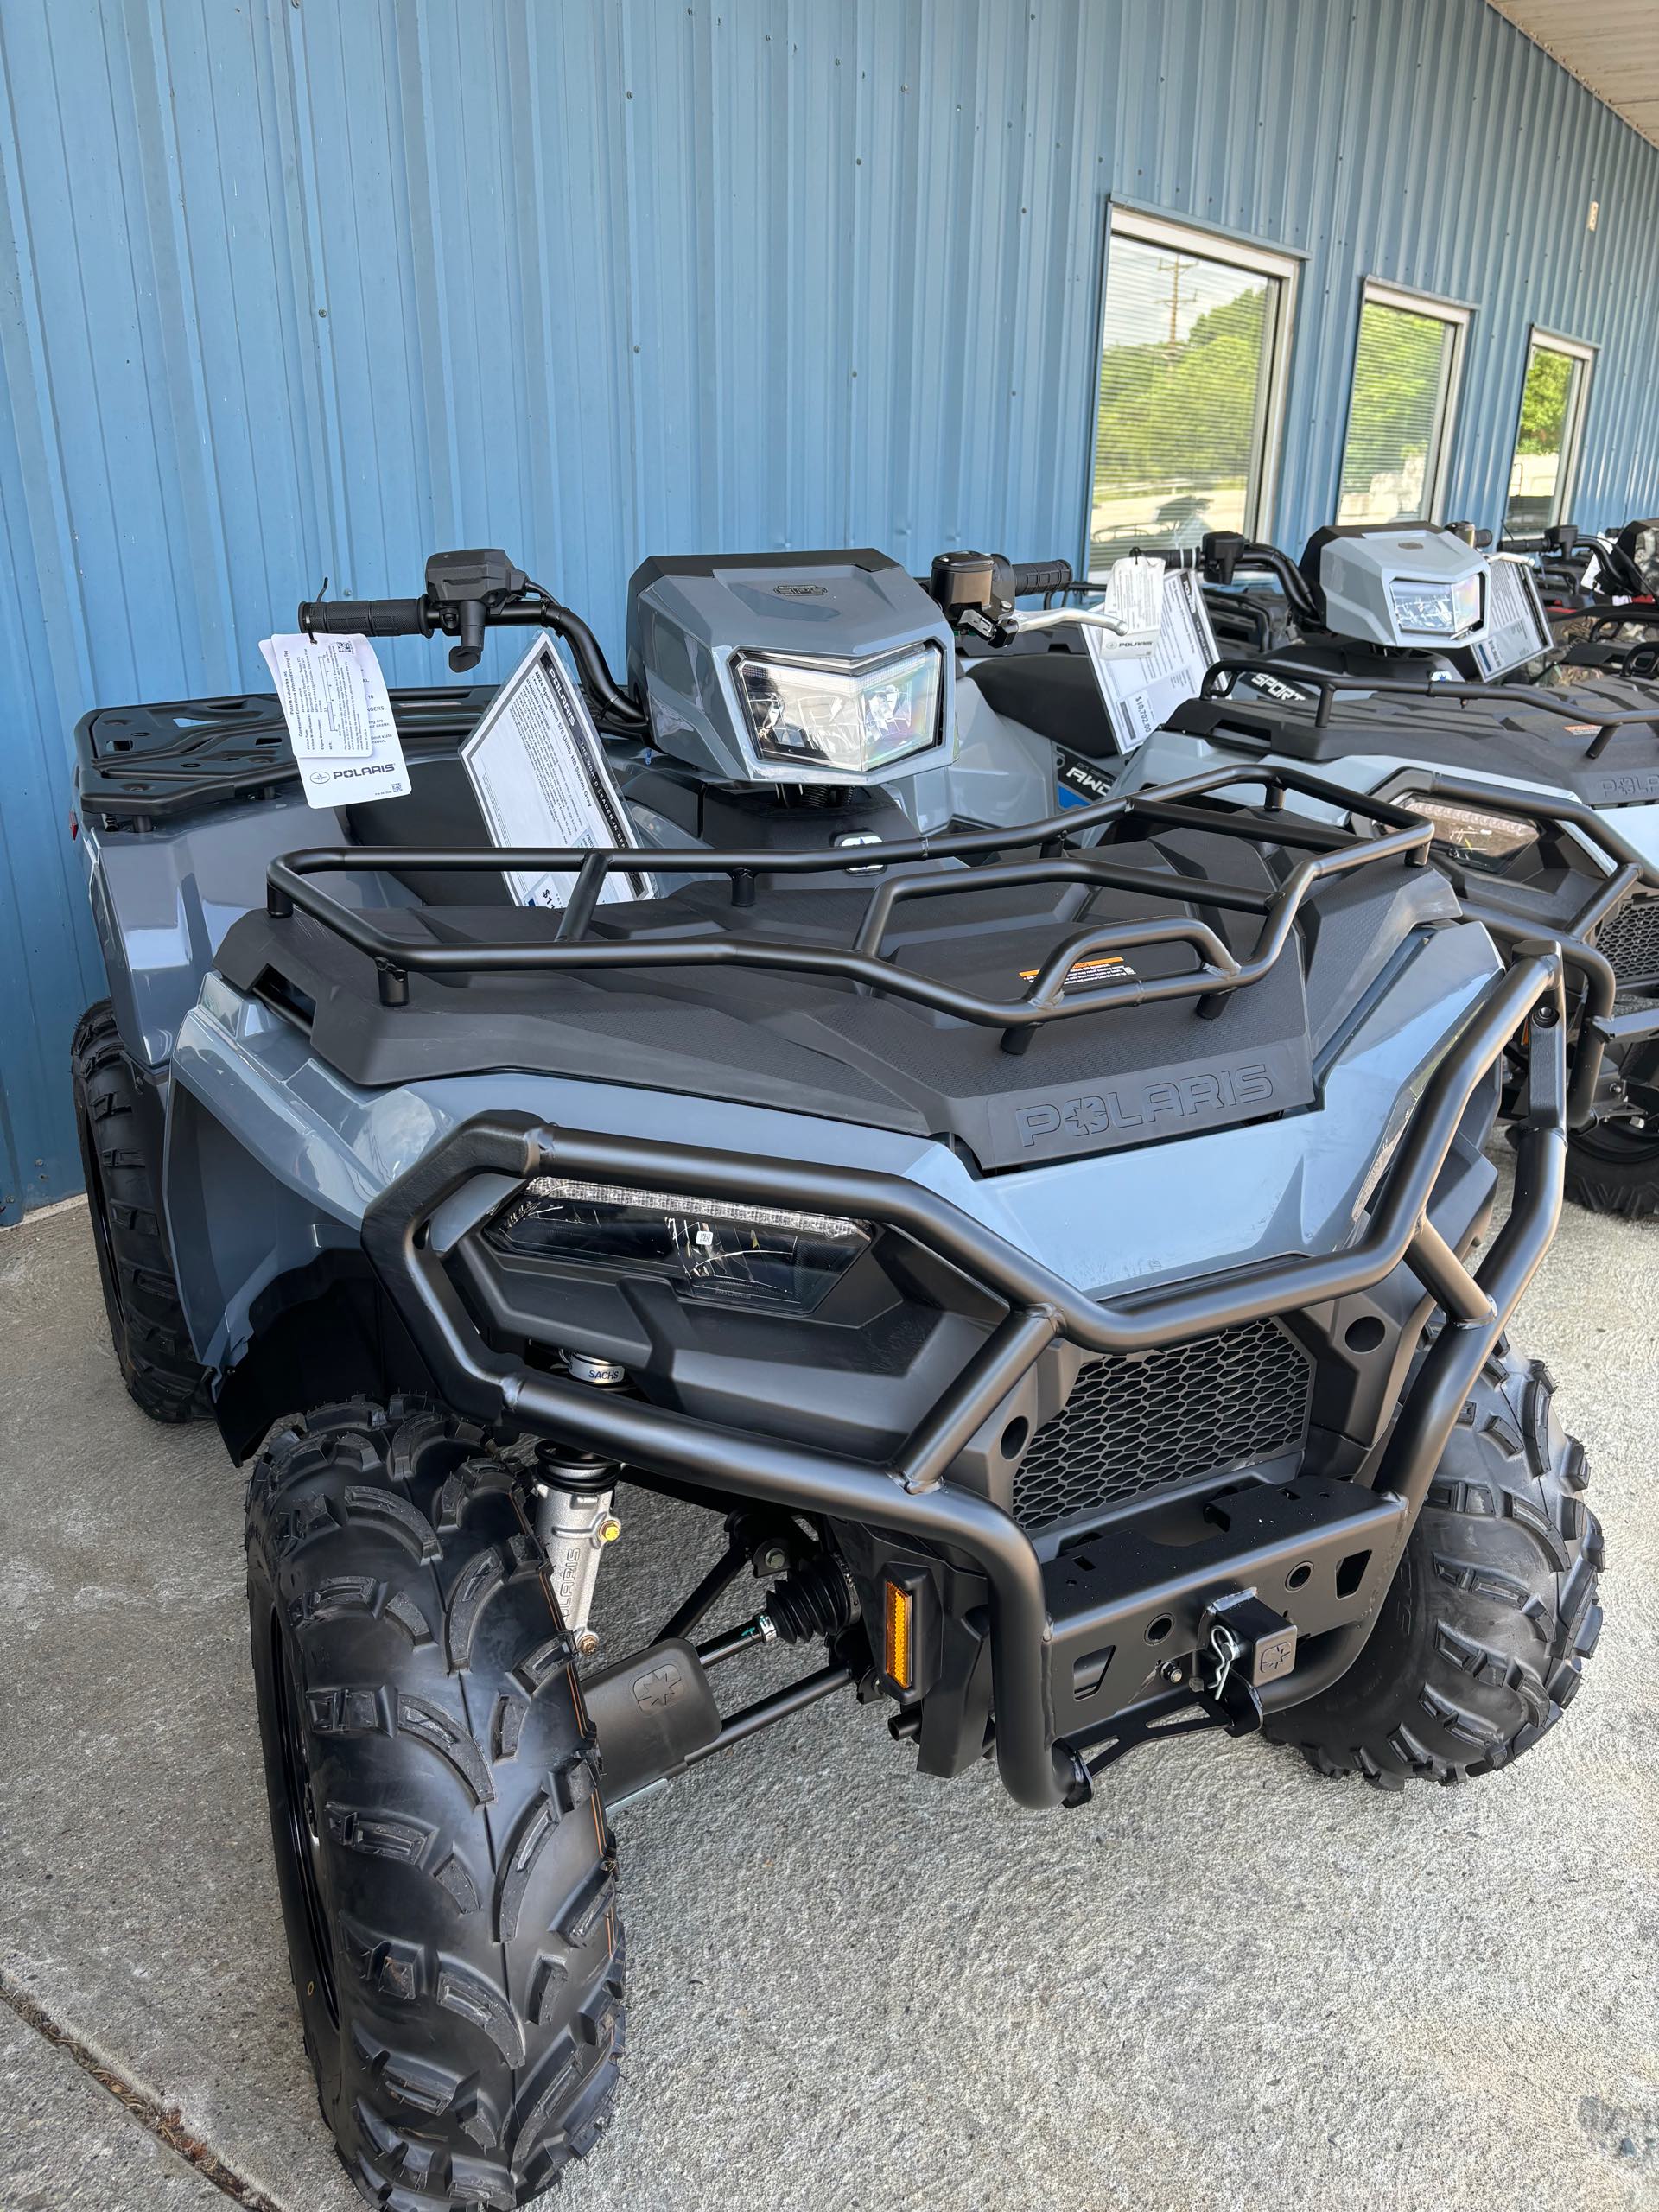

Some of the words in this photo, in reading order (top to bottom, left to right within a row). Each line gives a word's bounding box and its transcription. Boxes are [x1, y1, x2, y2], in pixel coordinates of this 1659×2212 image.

[535, 671, 543, 686] 2024
[543, 687, 559, 722] Sportsman
[563, 734, 572, 754] Utility
[571, 755, 577, 766] HD
[575, 766, 585, 791] Stealth
[1135, 696, 1151, 732] $10,702.00
[333, 764, 394, 779] POLARIS
[549, 668, 576, 727] POLARIS
[588, 760, 598, 786] WORLD
[598, 789, 613, 820] LEADER
[613, 822, 618, 831] IN
[1015, 1064, 1274, 1147] POLARIS
[589, 1370, 619, 1379] SACHS
